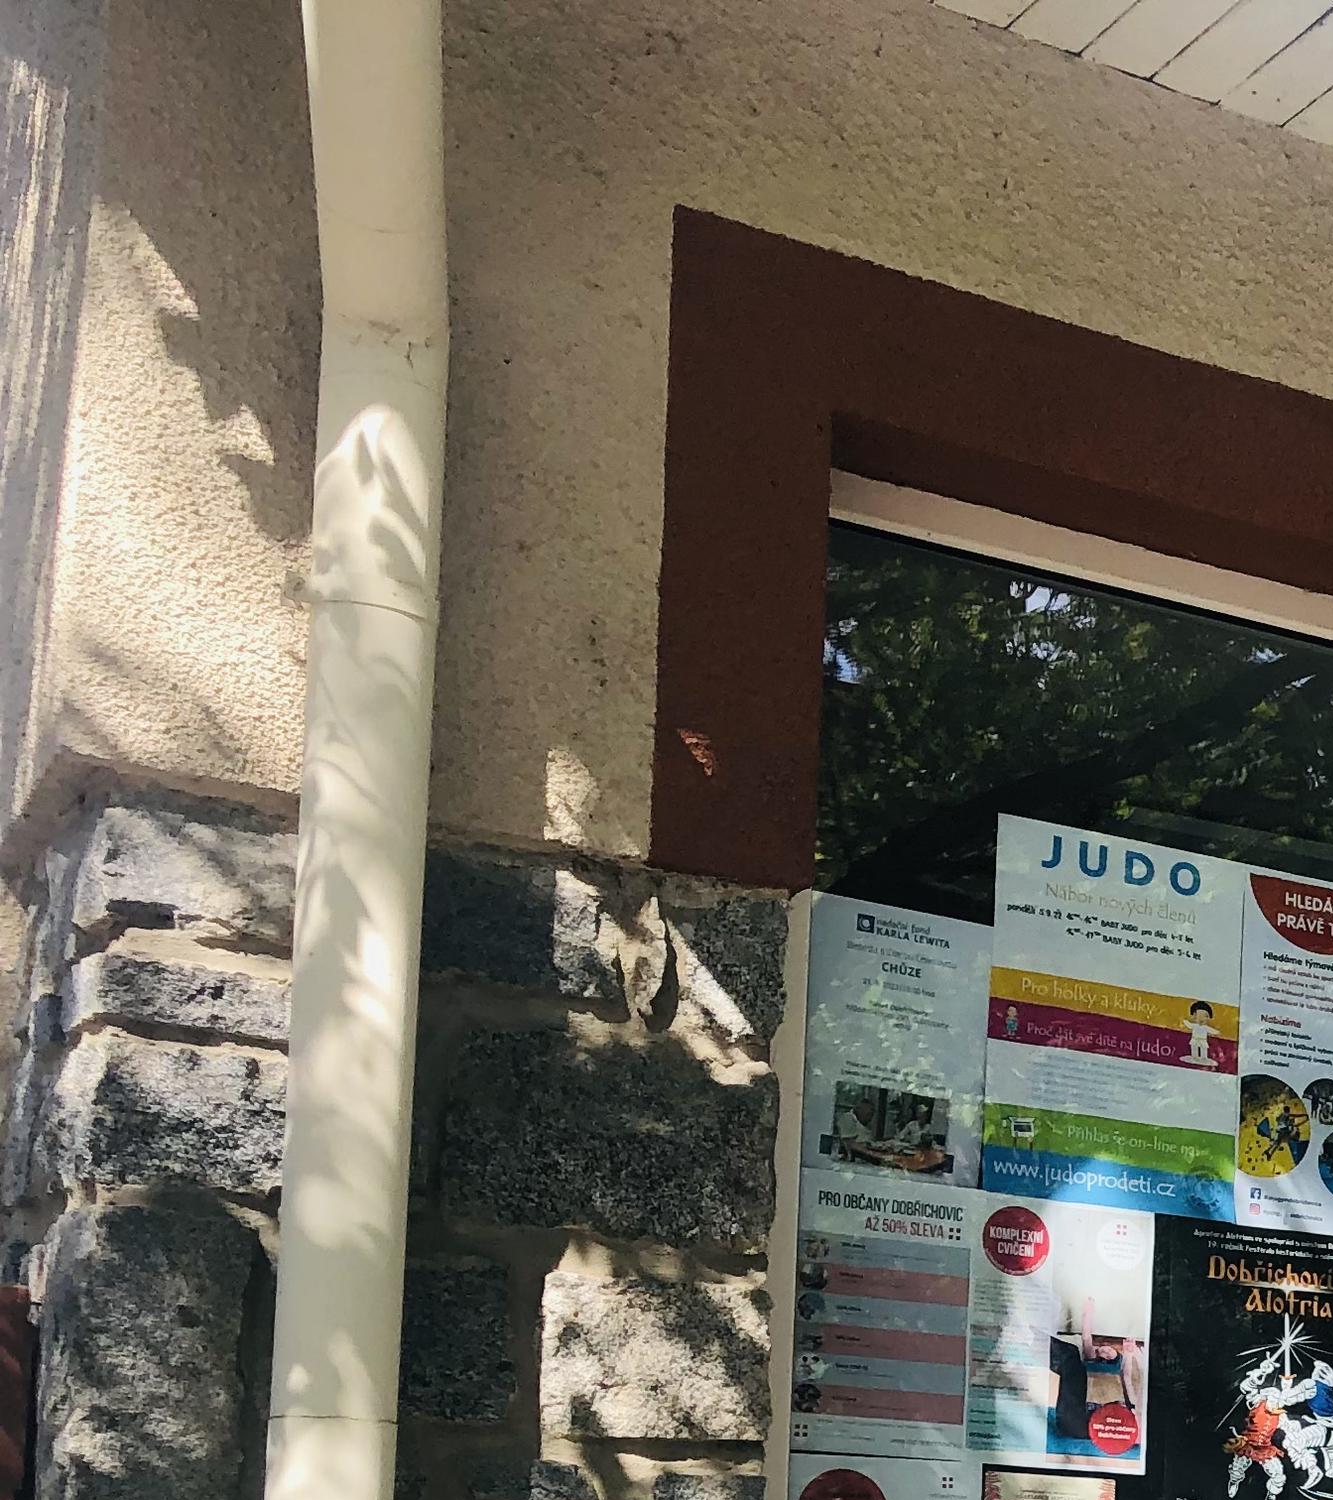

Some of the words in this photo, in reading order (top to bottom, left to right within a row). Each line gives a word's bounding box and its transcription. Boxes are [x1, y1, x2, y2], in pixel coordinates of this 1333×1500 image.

[1041, 834, 1201, 897] JUDO
[1045, 882, 1094, 904] Nábor
[1099, 896, 1153, 917] nových
[1157, 903, 1197, 924] členů
[1277, 912, 1325, 934] PRÁVĚ
[876, 926, 910, 941] KARLA
[914, 934, 951, 949] LEWITA
[881, 961, 922, 979] CHŮZE
[1263, 950, 1303, 967] Hledáme
[1021, 976, 1049, 996] Pro
[1052, 979, 1097, 1008] holky
[1100, 994, 1109, 1008] a
[1026, 1021, 1053, 1038] Proč
[1096, 1033, 1117, 1048] dítě
[1120, 1040, 1133, 1050] na
[1129, 1135, 1177, 1153] on-line
[993, 1158, 1177, 1198] www.judoprodeti.cz
[818, 1190, 841, 1207] PRO
[843, 1193, 890, 1214] OBČANY
[891, 1198, 964, 1222] DOBŘICHOVIC
[865, 1215, 880, 1232] AŽ
[881, 1218, 908, 1235] 50%
[910, 1222, 945, 1240] SLEVA
[989, 1225, 1044, 1244] KOMPLEXNÍ
[997, 1240, 1035, 1258] CVIČENÍ
[1245, 1287, 1333, 1319] Alotria
